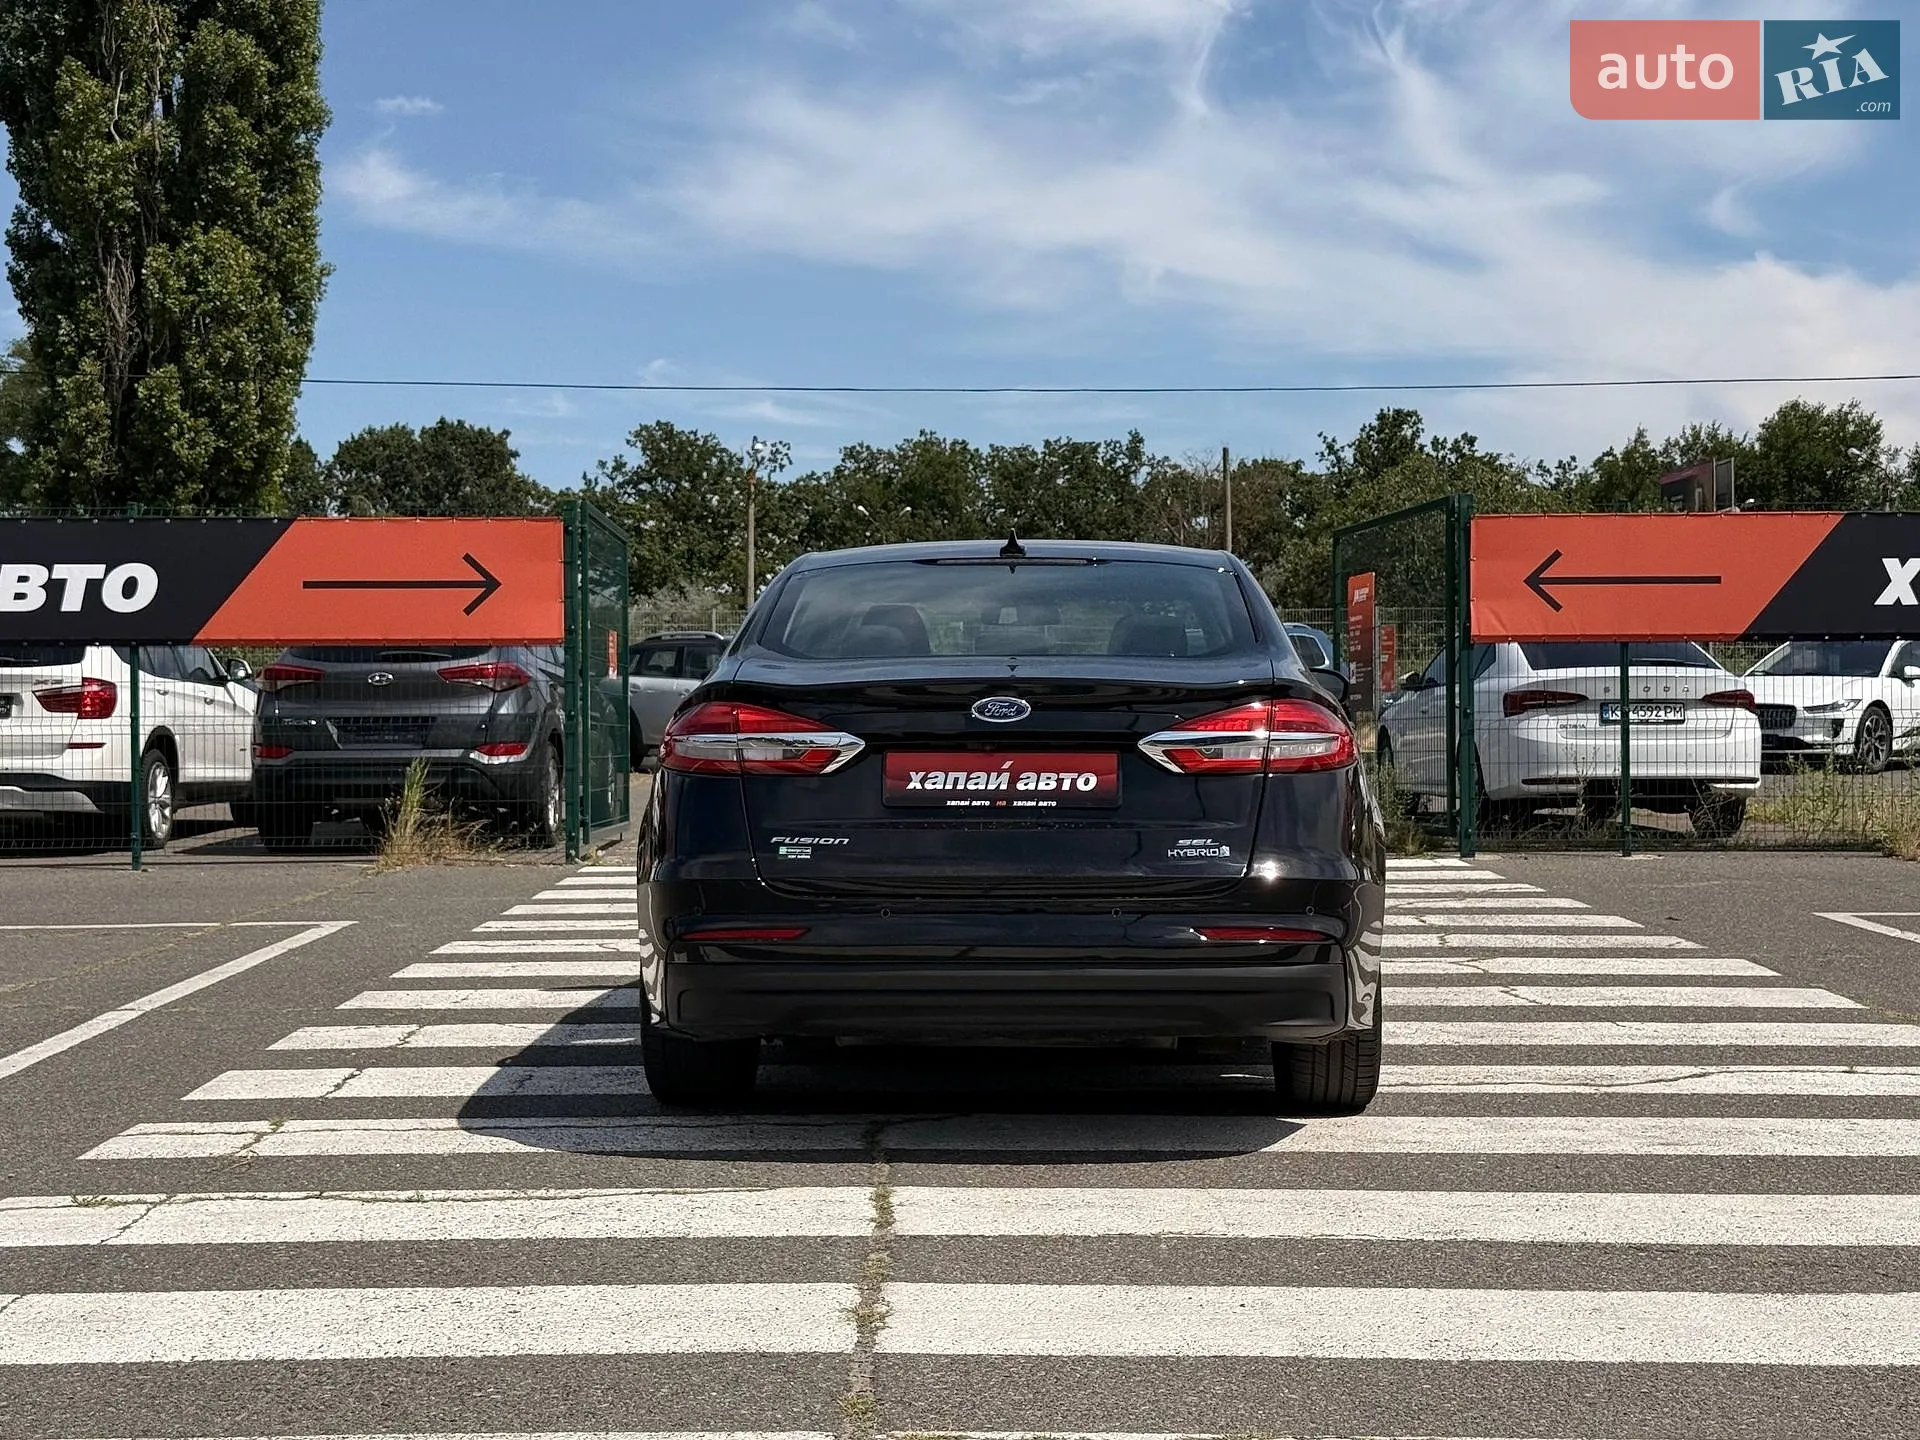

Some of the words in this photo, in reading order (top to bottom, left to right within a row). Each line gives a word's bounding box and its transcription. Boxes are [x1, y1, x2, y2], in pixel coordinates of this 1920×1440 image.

[1603, 685, 1690, 694] SODA
[984, 702, 1018, 717] Ford
[1632, 705, 1662, 718] 4592
[906, 760, 1015, 790] хапай
[1015, 772, 1098, 792] авто
[1176, 839, 1220, 847] SEL
[1167, 848, 1219, 857] HYBRID
